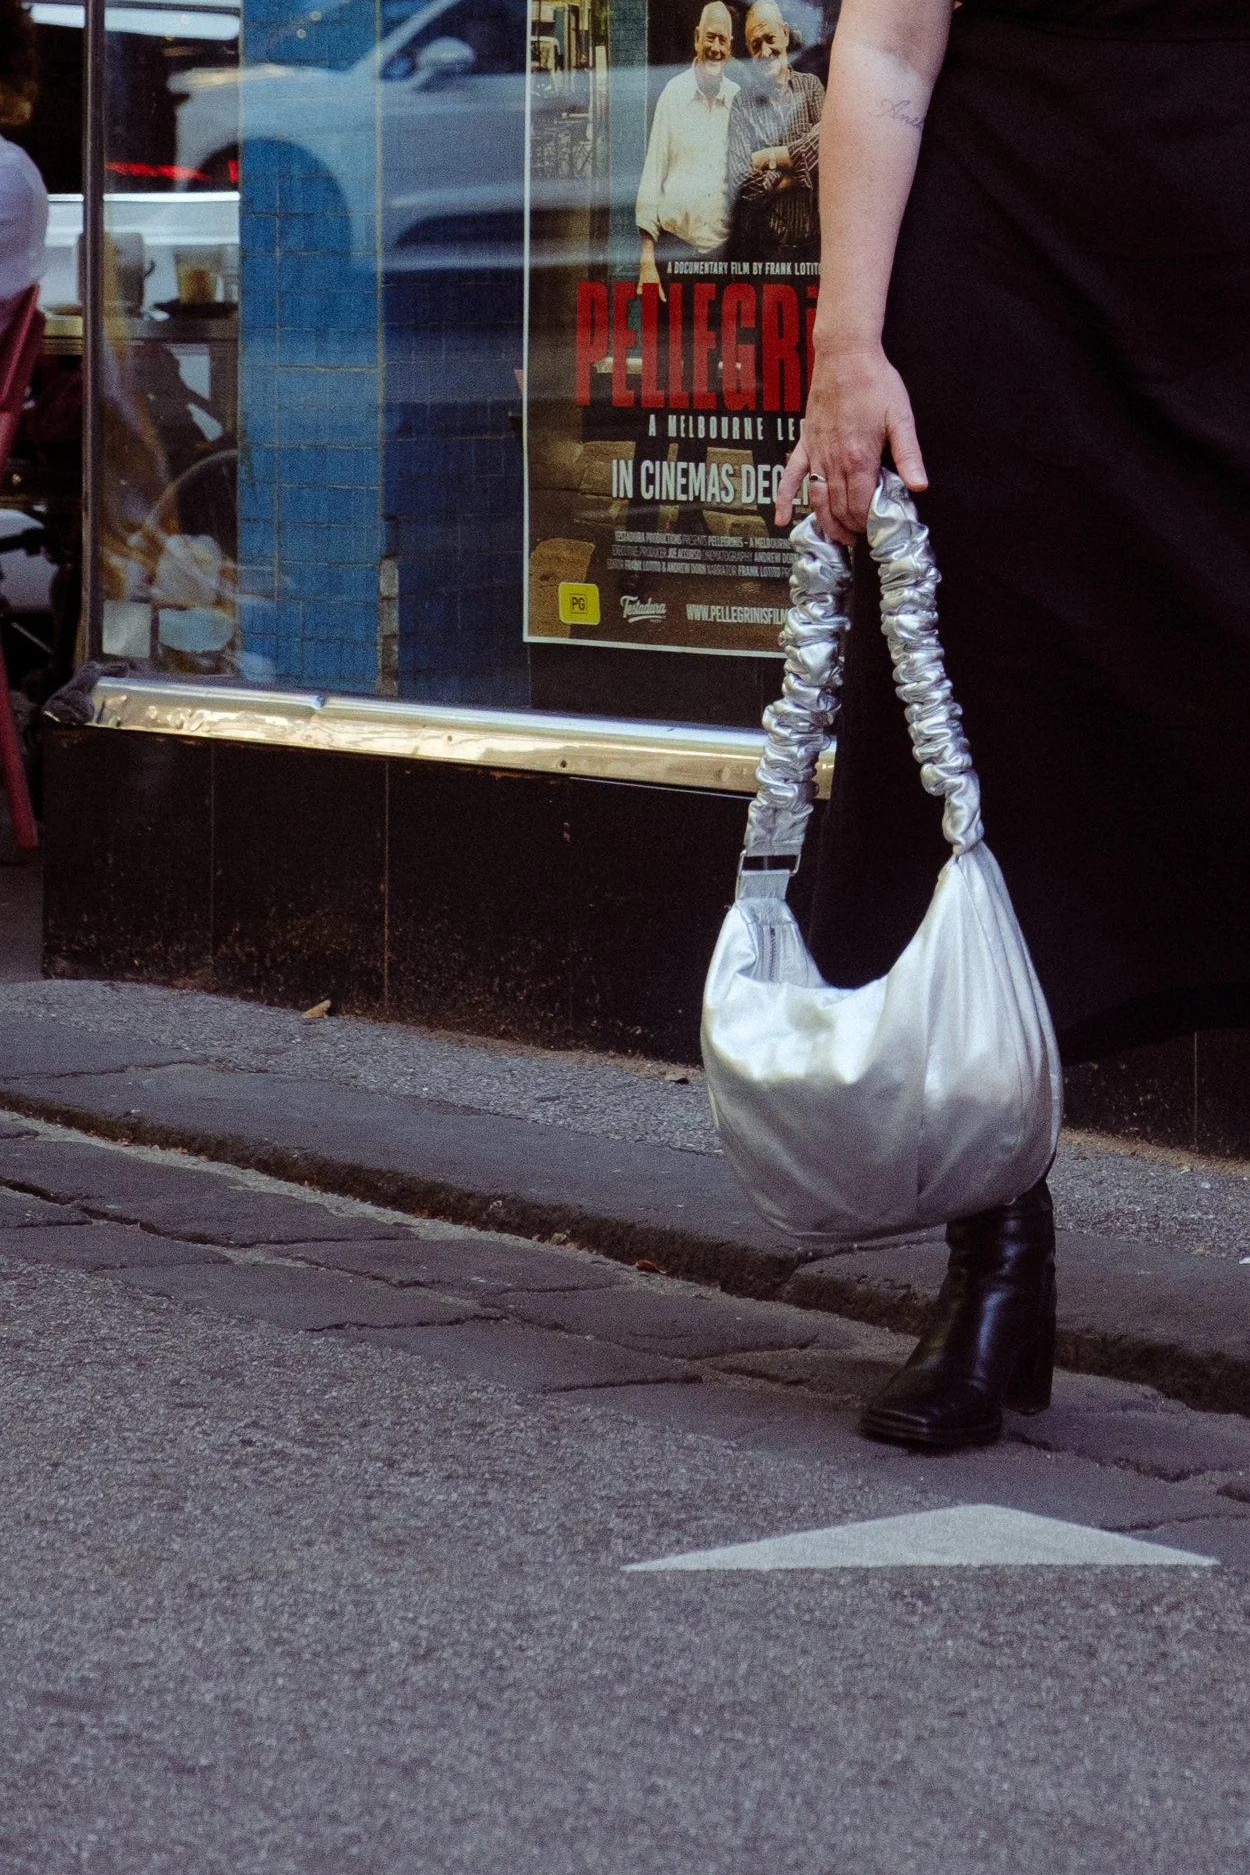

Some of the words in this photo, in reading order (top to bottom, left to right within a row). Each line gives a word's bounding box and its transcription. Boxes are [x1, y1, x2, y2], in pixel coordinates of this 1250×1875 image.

[667, 261, 672, 274] A
[674, 261, 728, 275] DOCUMENTARY
[731, 262, 750, 275] FILM
[753, 262, 762, 275] BY
[765, 262, 792, 275] FRANK
[648, 414, 656, 437] A
[668, 415, 764, 441] MELBOURNE
[611, 459, 633, 500] IN
[640, 460, 735, 504] CINEMAS
[571, 596, 586, 611] PG
[620, 595, 667, 619] Testadura
